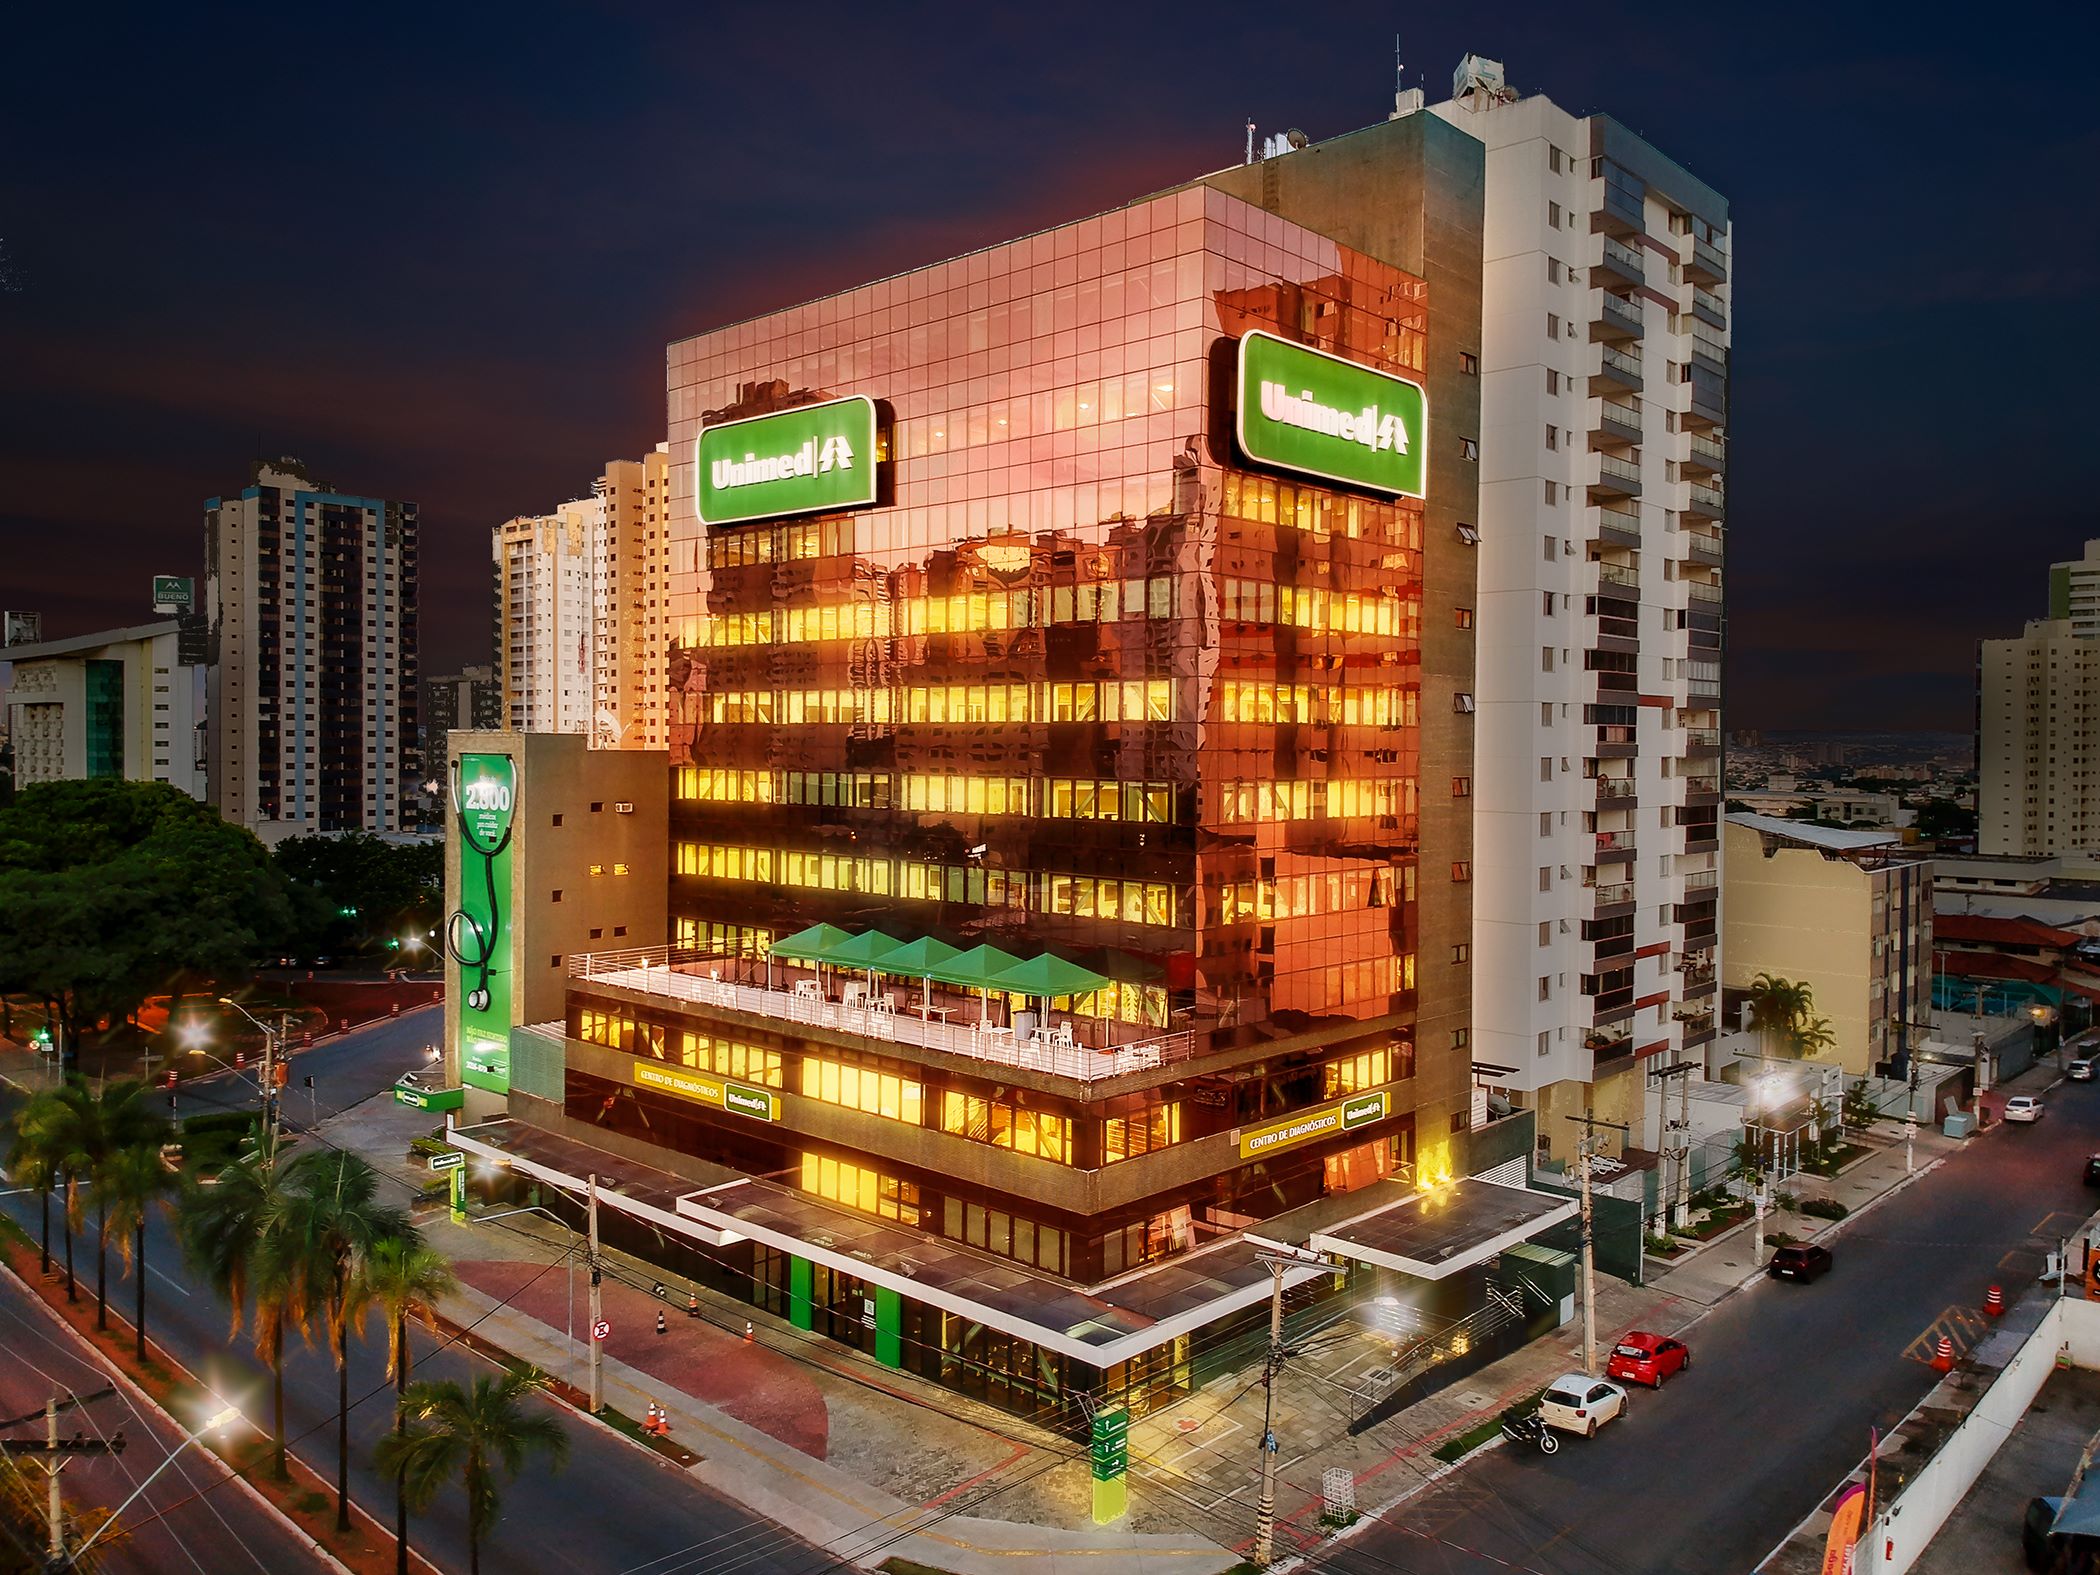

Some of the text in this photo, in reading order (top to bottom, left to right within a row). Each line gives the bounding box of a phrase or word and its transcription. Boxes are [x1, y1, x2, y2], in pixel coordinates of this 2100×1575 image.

[1261, 380, 1373, 447] Unimed
[712, 441, 814, 490] Unimed
[157, 592, 189, 601] BUENO
[640, 1070, 719, 1098] CENTRO DE DIAGNÓSTICOS
[728, 1093, 757, 1109] Unimed
[1346, 1103, 1371, 1120] Unimed
[1250, 1115, 1337, 1149] CENTRO DE DIAGNÓSTICOS
